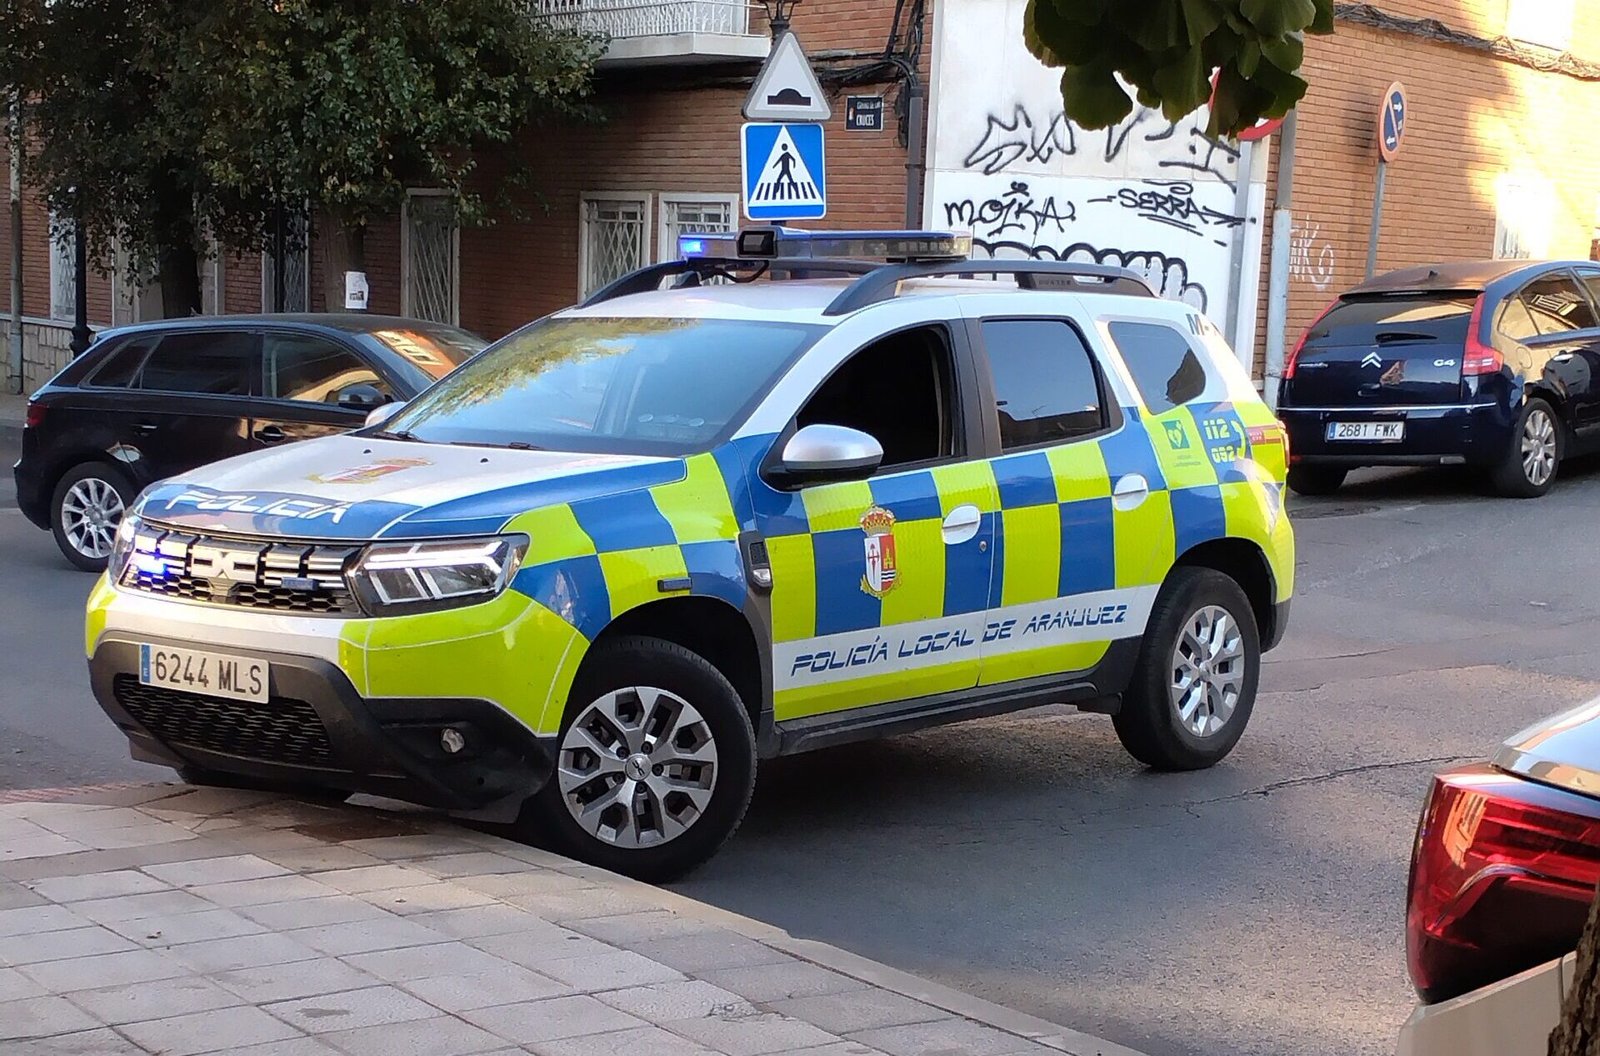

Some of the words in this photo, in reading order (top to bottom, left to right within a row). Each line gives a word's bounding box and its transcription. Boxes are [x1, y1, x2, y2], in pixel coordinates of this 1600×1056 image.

[1203, 418, 1231, 440] 112
[1338, 424, 1368, 437] 2681
[1374, 424, 1398, 437] FWK
[790, 635, 889, 677] POLICÍA
[898, 629, 975, 658] LOCAL
[982, 620, 1017, 643] DE
[1023, 605, 1128, 636] ARANJUEZ
[155, 651, 209, 688] 6244
[218, 660, 262, 695] MLS
